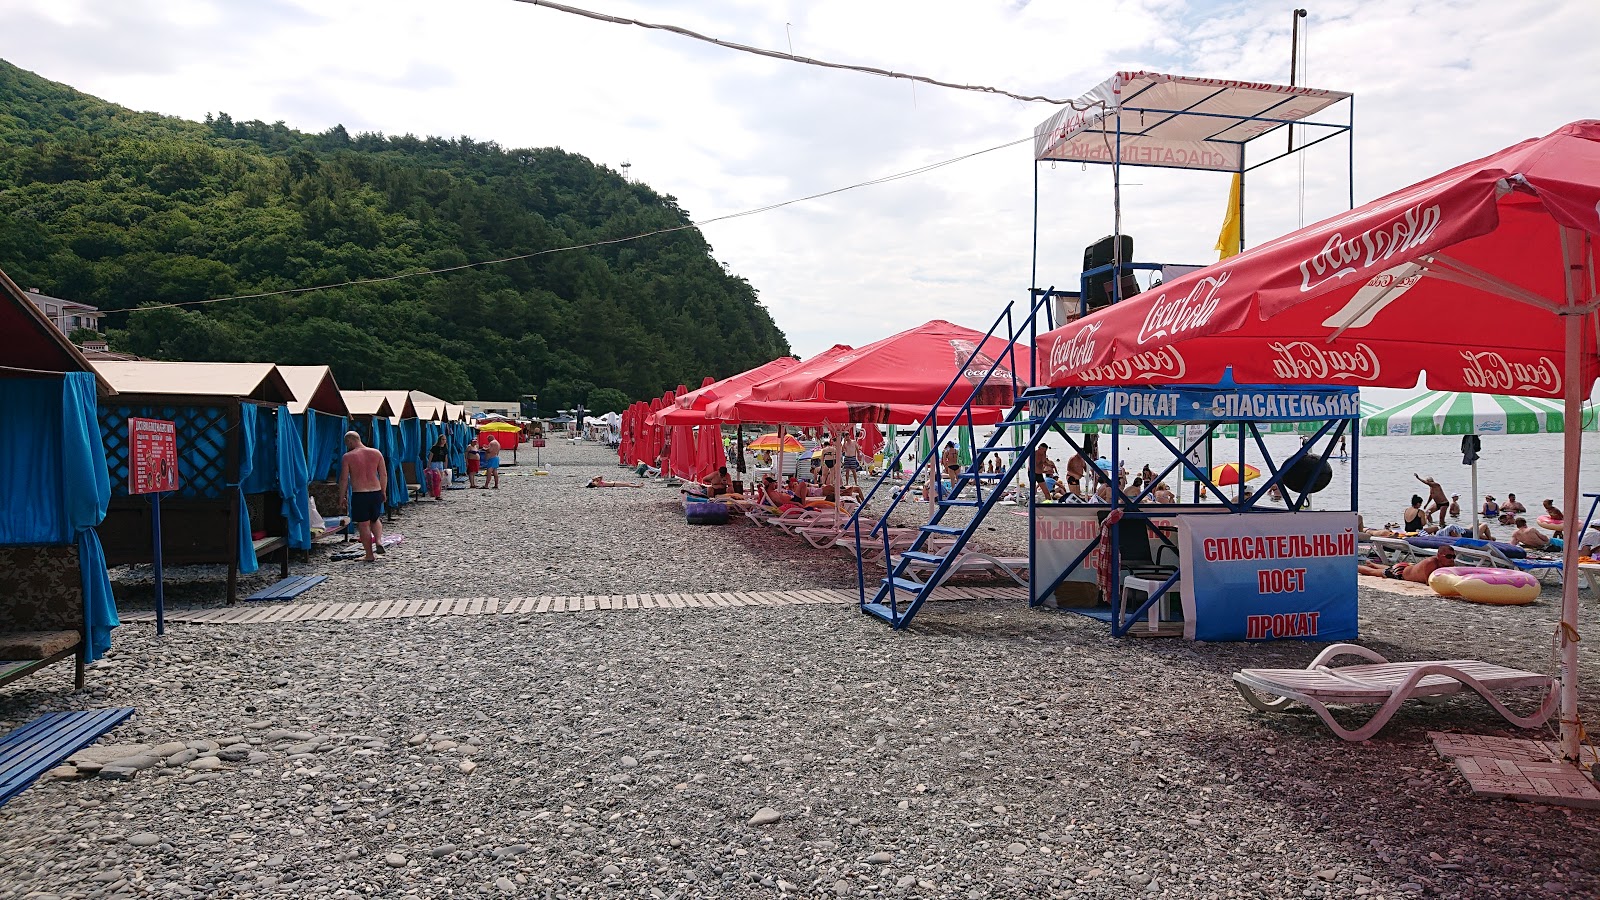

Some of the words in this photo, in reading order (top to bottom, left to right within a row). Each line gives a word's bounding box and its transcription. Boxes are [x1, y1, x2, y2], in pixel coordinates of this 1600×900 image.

[1299, 203, 1443, 293] CocaCola
[1104, 391, 1180, 417] ПРОКАТ
[1212, 392, 1360, 418] СПАСАТЕЛЬНАЯ
[1203, 527, 1355, 562] СПАСАТЕЛЬНЫЙ
[1257, 568, 1306, 595] ПОСТ
[1245, 611, 1320, 640] ПРОКАТ
